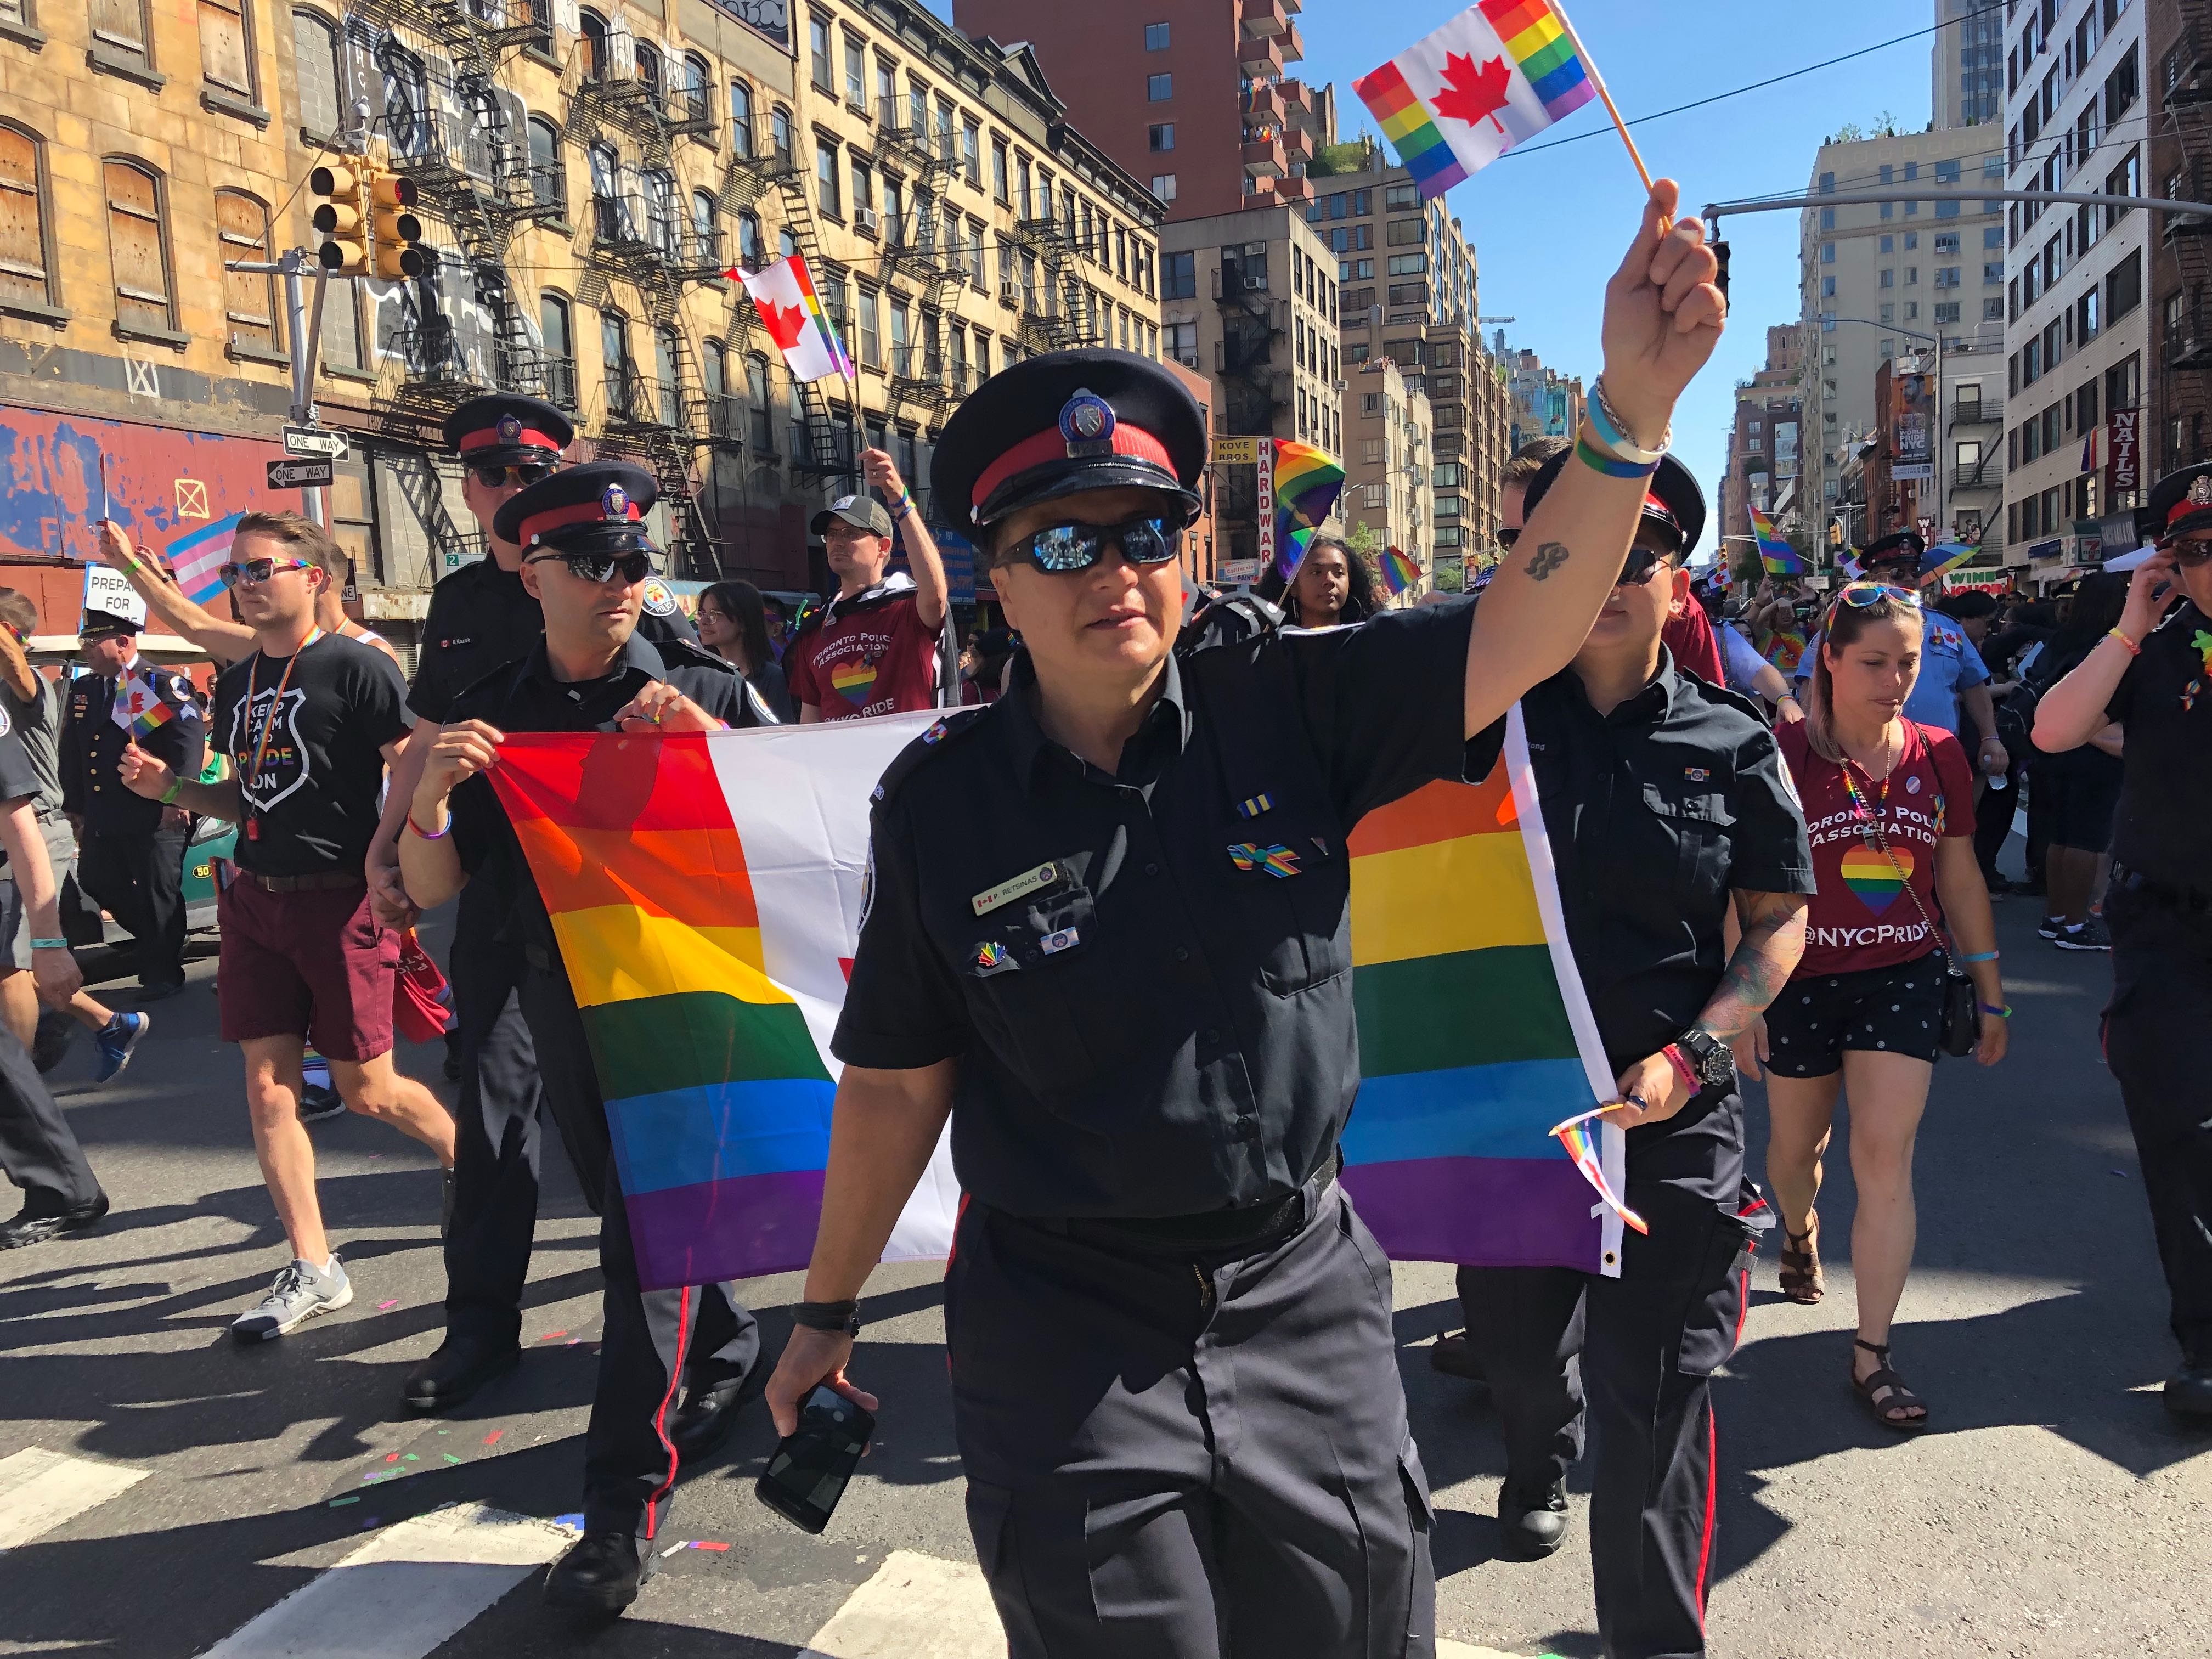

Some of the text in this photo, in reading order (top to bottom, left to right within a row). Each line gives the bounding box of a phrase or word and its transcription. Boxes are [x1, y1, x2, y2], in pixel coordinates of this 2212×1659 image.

[290, 435, 339, 451] ONE WAY
[1219, 442, 1249, 450] KOVE
[1899, 440, 1925, 450] NYC
[2113, 413, 2137, 487] NAILS
[1218, 453, 1253, 461] BROS.
[276, 466, 326, 481] ONE WAY
[2084, 540, 2100, 561] 7
[449, 555, 456, 566] 2
[1227, 565, 1254, 574] California
[91, 577, 134, 592] PREPA
[1949, 571, 1996, 584] WINE
[106, 596, 129, 610] FOR
[655, 601, 674, 613] POLICE
[812, 632, 893, 666] TORONTO POLIC
[250, 702, 284, 718] KEP
[253, 733, 273, 744] AD
[250, 772, 276, 789] ON
[198, 866, 210, 877] 50
[1002, 876, 1037, 896] RETSINAS
